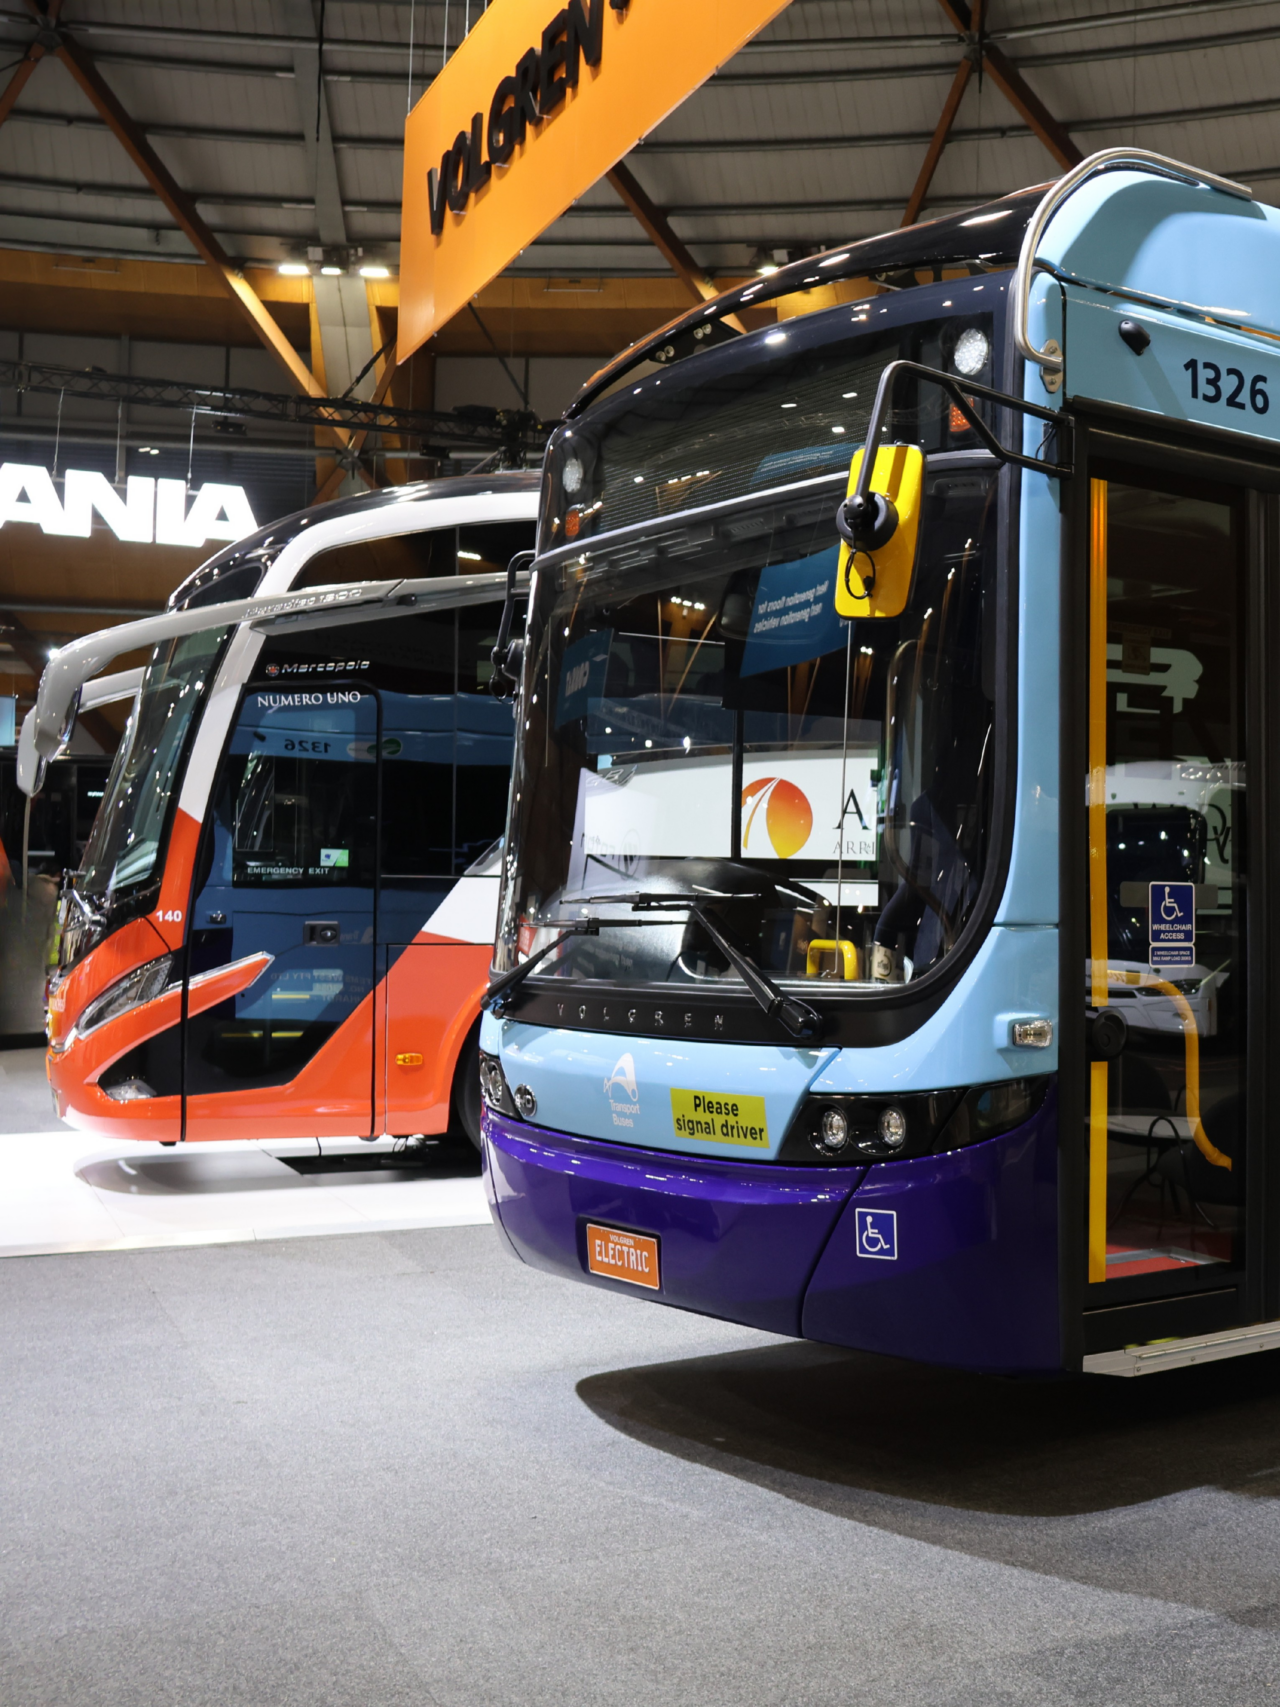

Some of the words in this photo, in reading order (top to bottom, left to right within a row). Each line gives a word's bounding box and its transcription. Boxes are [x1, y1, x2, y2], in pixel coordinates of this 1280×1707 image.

[427, 0, 604, 236] VOLGREN
[1183, 358, 1270, 415] 1326
[281, 660, 370, 673] Marcopolo
[257, 693, 323, 707] NUMERO
[327, 691, 361, 704] UNO
[156, 910, 182, 922] 140
[557, 1003, 724, 1031] VOLGREN
[609, 1099, 640, 1114] Transport
[693, 1095, 739, 1117] Please
[612, 1113, 634, 1128] Buses
[675, 1114, 716, 1137] signal
[720, 1119, 765, 1141] driver
[609, 1234, 634, 1246] VOLGREN
[595, 1239, 649, 1273] ELECTRIC
